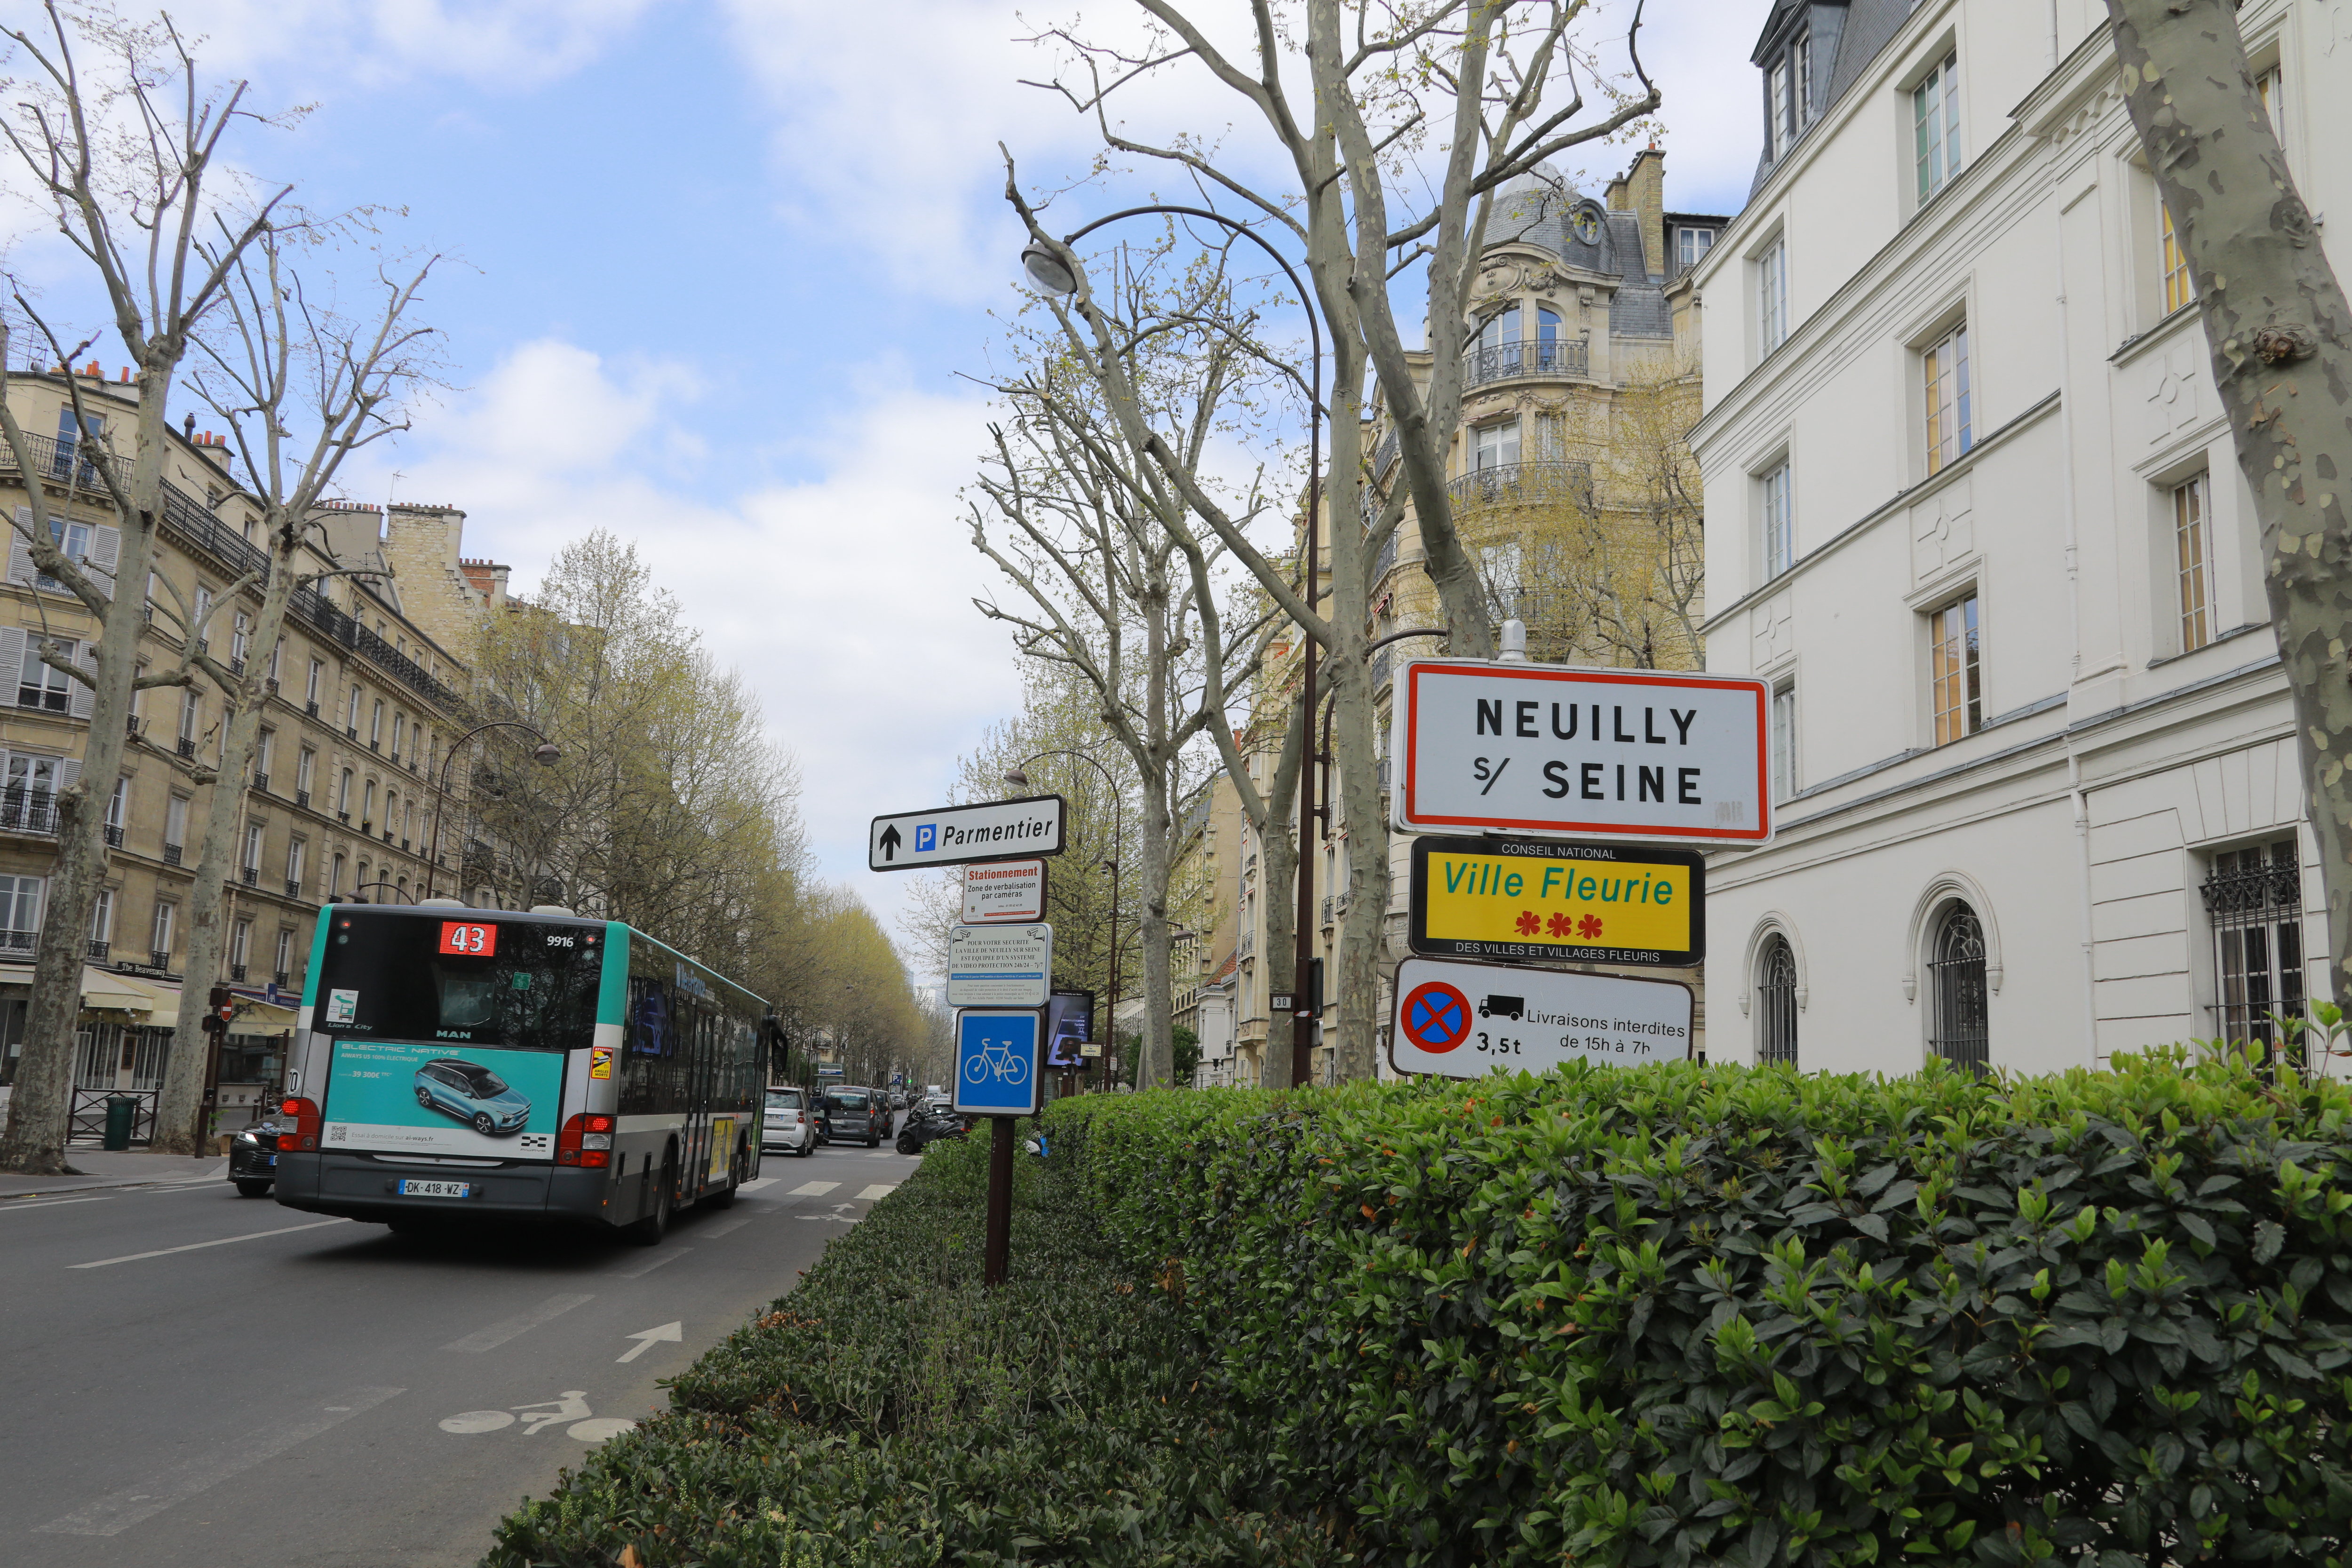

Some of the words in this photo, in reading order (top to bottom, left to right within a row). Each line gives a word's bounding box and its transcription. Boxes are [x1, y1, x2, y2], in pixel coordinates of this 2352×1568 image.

[1477, 699, 1697, 745] NEUILLY
[1474, 757, 1510, 796] S/
[1542, 760, 1701, 805] SEINE
[919, 828, 932, 849] P
[943, 817, 1053, 846] Parmentier
[1502, 844, 1554, 856] CONSEIL
[1557, 846, 1616, 860] NATIONAL
[969, 867, 1038, 881] Stationnement
[1446, 861, 1523, 897] Ville
[1541, 867, 1673, 905] Fleurie
[994, 881, 1036, 891] verbalisation
[994, 890, 1023, 899] caméras
[451, 926, 485, 952] 43
[547, 936, 574, 947] 9916
[1455, 942, 1481, 954] DES
[1484, 943, 1525, 956] VILLES
[1529, 945, 1544, 956] ET
[1547, 946, 1605, 959] VILLAGES
[1609, 949, 1660, 962] FLEURIS
[122, 963, 133, 971] The
[1527, 1010, 1608, 1029] Livraisons
[1613, 1018, 1685, 1037] interdites
[437, 1030, 471, 1039] MAN
[342, 1044, 405, 1052] ELECTRIC
[1560, 1034, 1579, 1048] de
[1585, 1037, 1610, 1051] 15h
[1615, 1039, 1624, 1053] à
[1632, 1041, 1650, 1055] 7h
